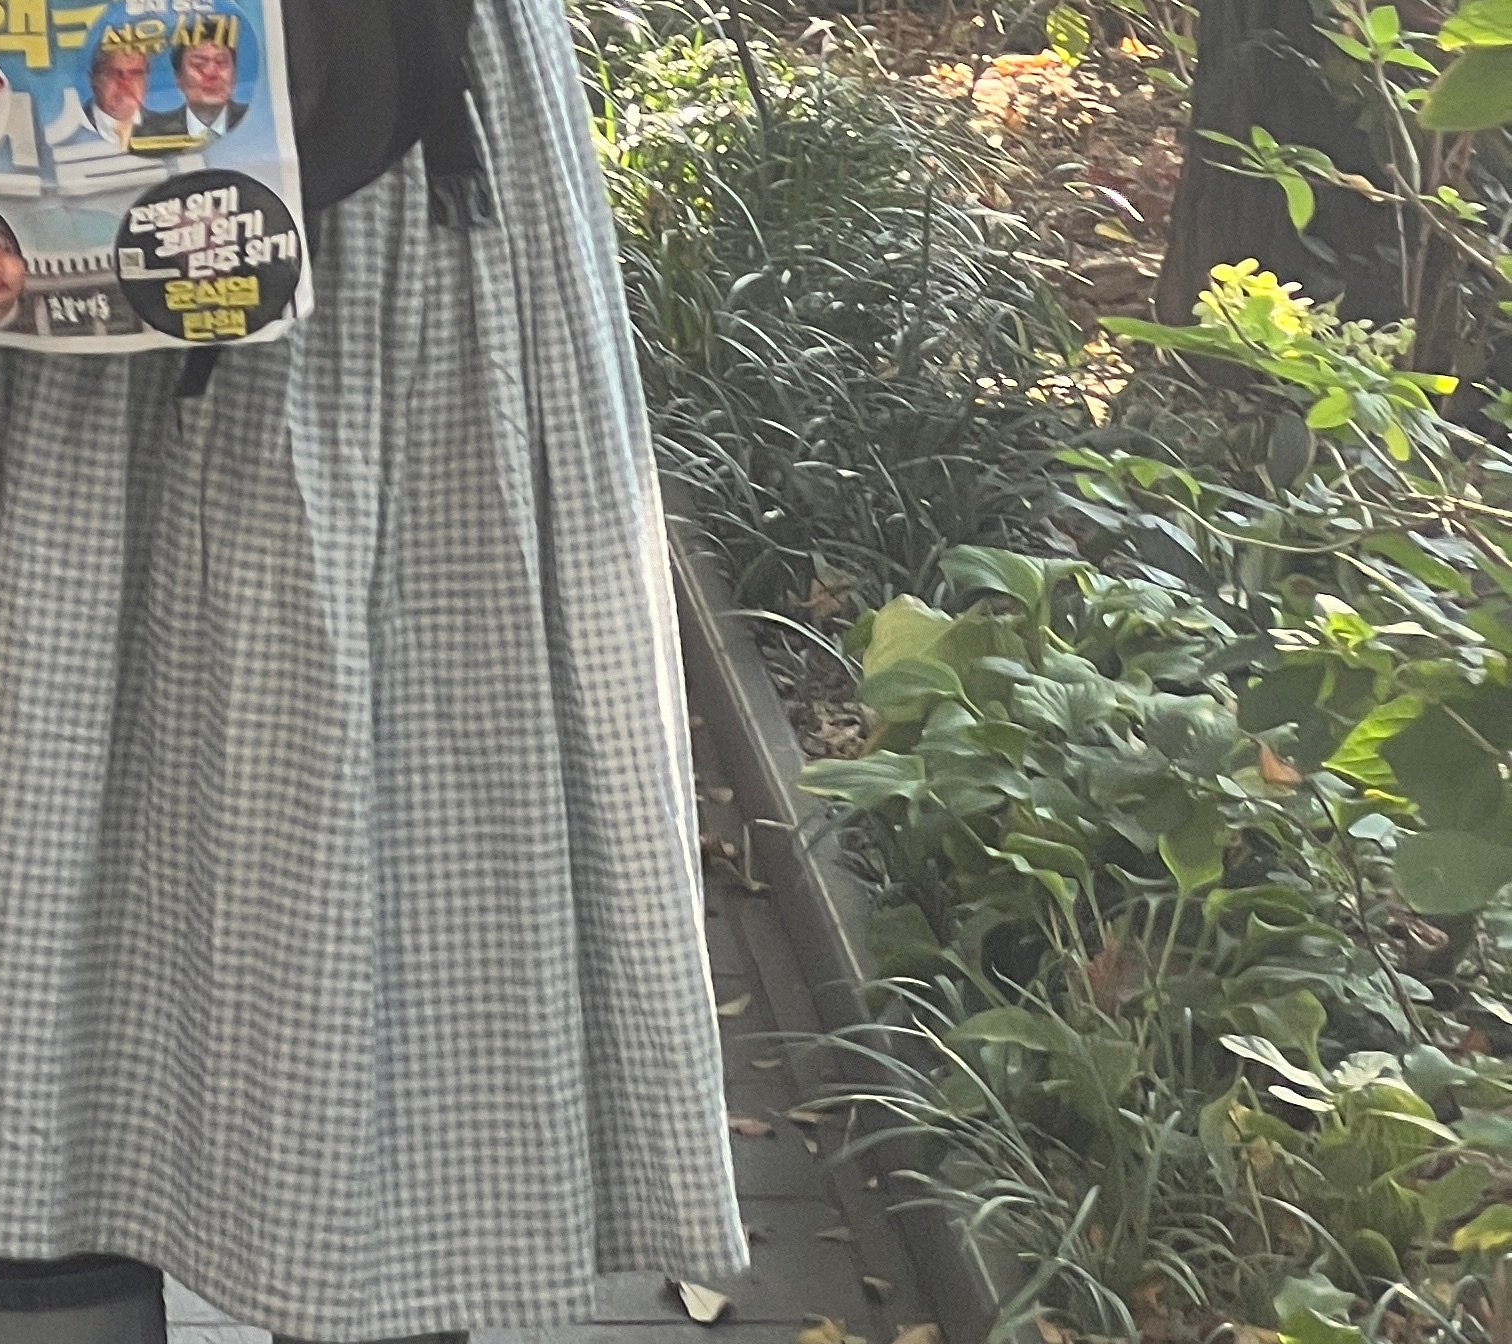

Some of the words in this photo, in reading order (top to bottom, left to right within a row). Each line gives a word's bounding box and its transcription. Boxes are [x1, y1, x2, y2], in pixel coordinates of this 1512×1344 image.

[170, 13, 240, 48] 사기
[129, 197, 182, 233] 전쟁
[186, 186, 238, 221] 위기
[211, 210, 263, 245] 위기
[244, 230, 298, 266] 위기
[165, 275, 260, 311] 윤석열
[183, 308, 247, 340] 탄핵
